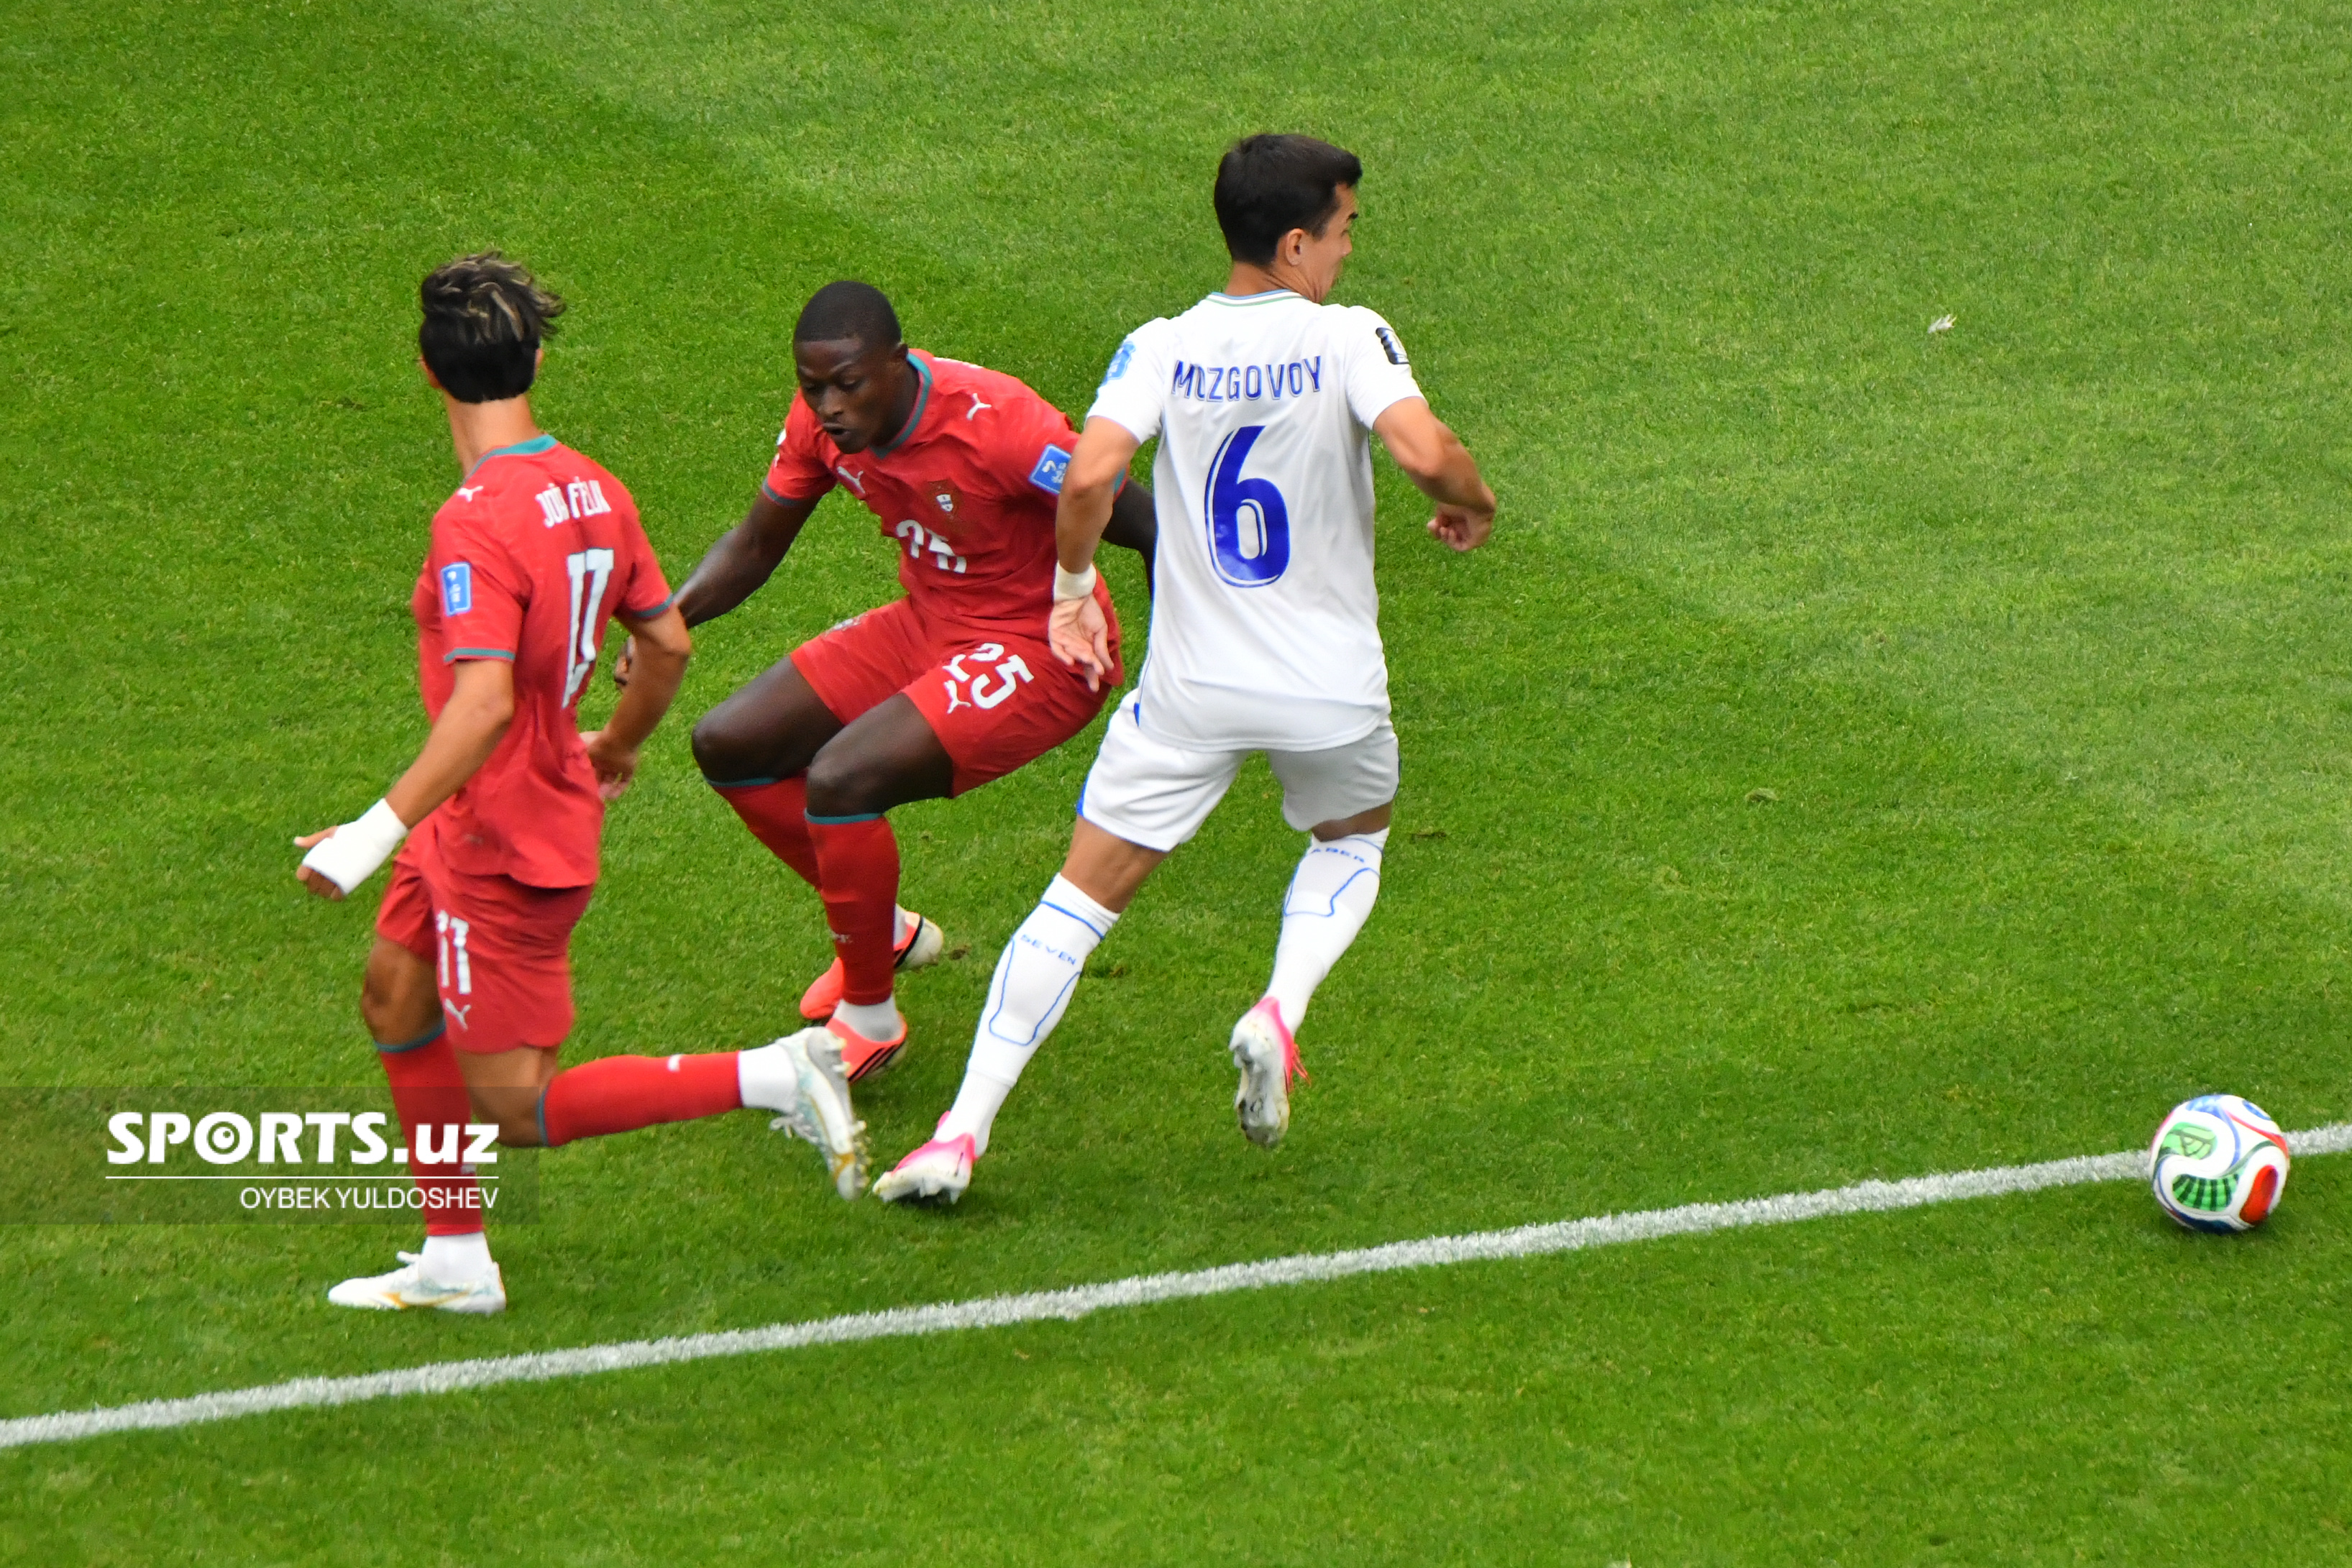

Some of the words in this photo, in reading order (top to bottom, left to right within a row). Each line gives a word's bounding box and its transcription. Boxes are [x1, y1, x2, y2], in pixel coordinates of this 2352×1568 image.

[1171, 355, 1322, 403] MOZGOVOY
[1204, 426, 1291, 588] 6
[561, 548, 615, 709] 17
[942, 641, 1035, 710] 25
